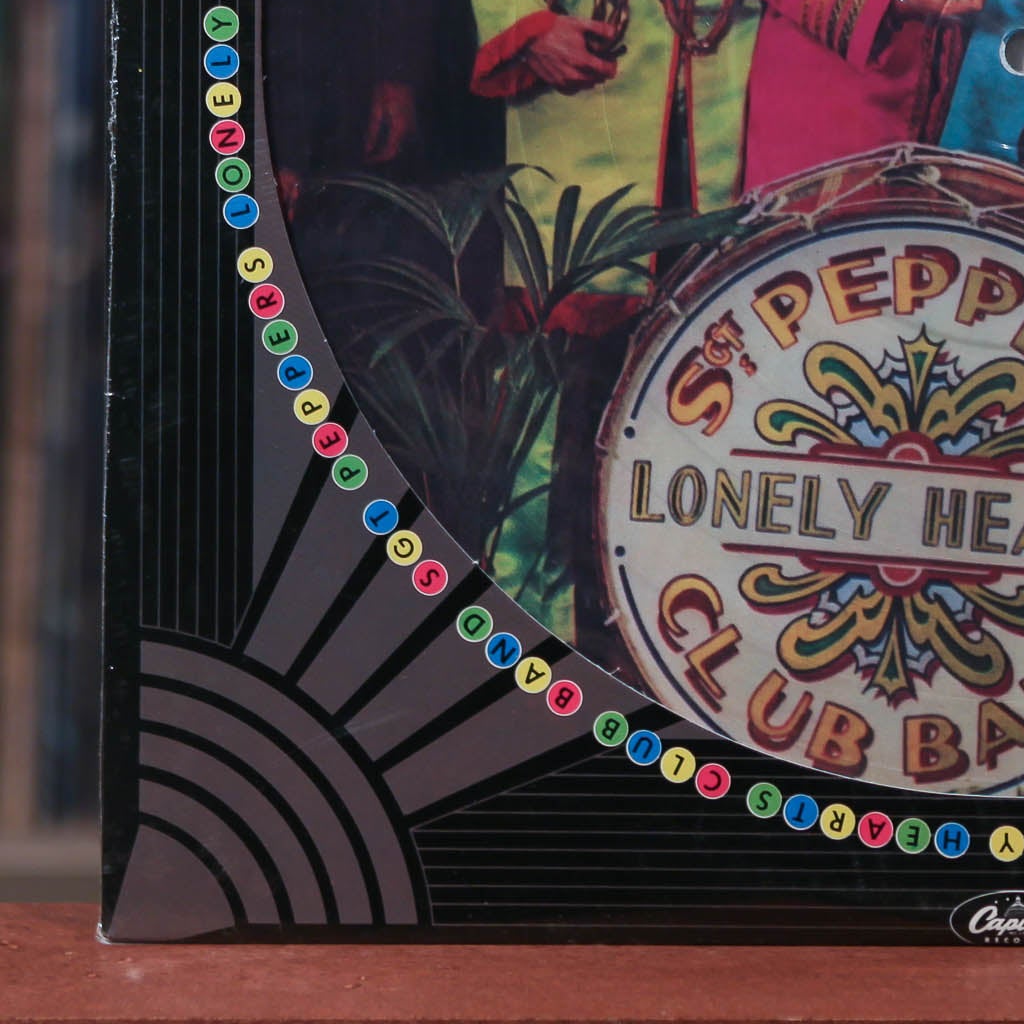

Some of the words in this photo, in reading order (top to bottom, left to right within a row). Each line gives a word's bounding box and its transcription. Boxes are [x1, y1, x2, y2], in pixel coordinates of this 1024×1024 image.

[210, 15, 252, 219] LONELY
[243, 256, 362, 483] PEPPERS
[628, 460, 892, 541] LONELY
[368, 509, 440, 588] SGT
[462, 612, 575, 710] BAND
[657, 572, 875, 776] CLUB
[600, 717, 723, 792] CLUB
[755, 789, 962, 852] HEARTS
